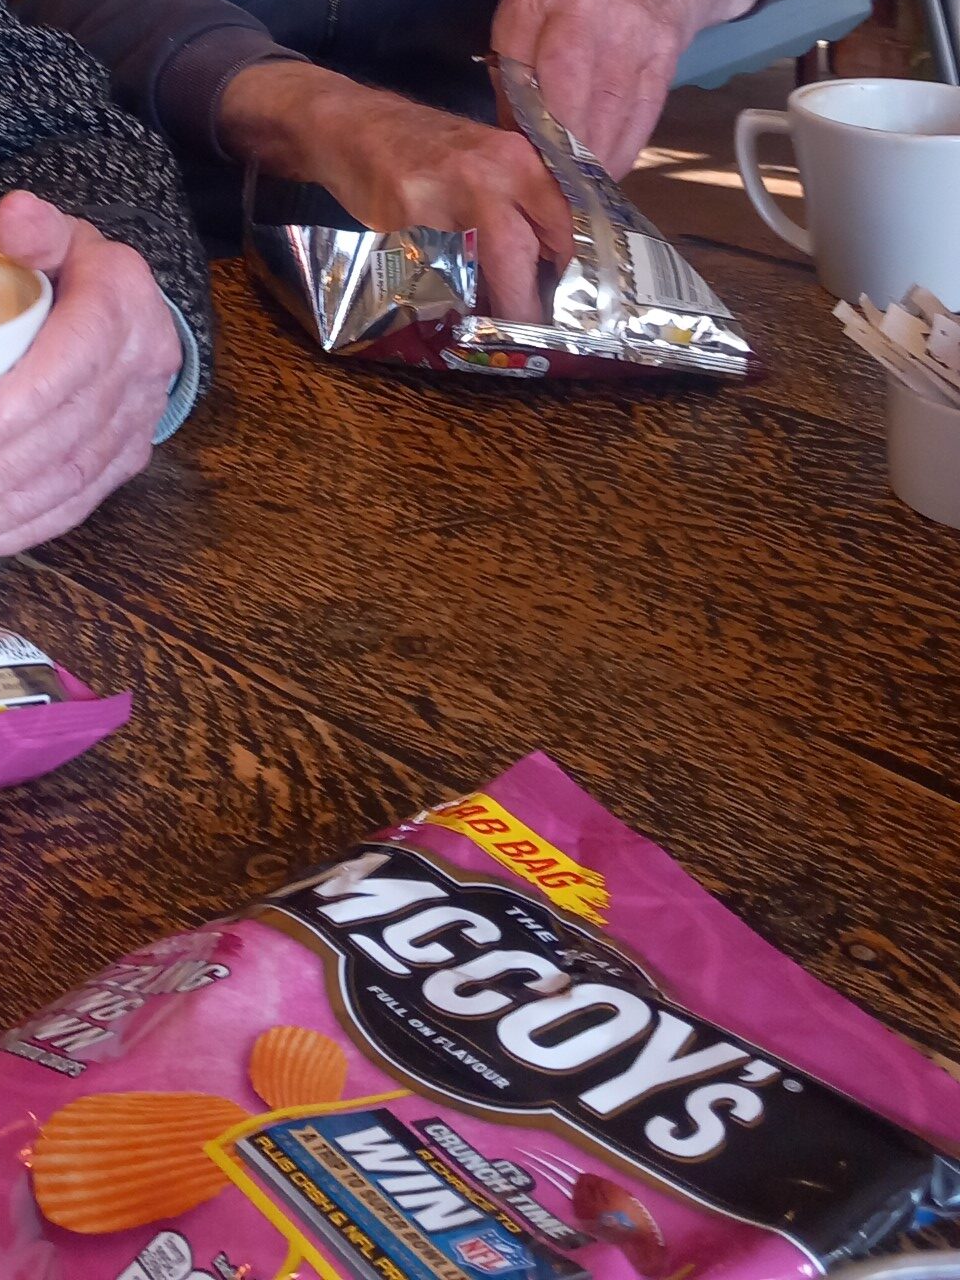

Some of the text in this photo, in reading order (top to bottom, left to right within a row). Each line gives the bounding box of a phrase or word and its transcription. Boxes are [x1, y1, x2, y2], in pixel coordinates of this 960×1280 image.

[492, 839, 586, 889] BAG
[504, 905, 559, 943] THE
[366, 985, 510, 1089] FULL ON FLAVOUR
[255, 1136, 297, 1173] PLUS
[290, 1172, 337, 1213] CASH
[342, 1225, 376, 1260] NFL
[299, 1132, 318, 1144] A
[310, 1143, 350, 1171] TRIP
[341, 1171, 367, 1188] TO
[359, 1189, 410, 1230] SUPER
[401, 1232, 448, 1269] BOWL
[334, 1125, 485, 1232] WIN
[415, 1148, 522, 1233] A CHANCE TO
[424, 1124, 578, 1240] CRUNCH TIME
[459, 1237, 508, 1270] NFL
